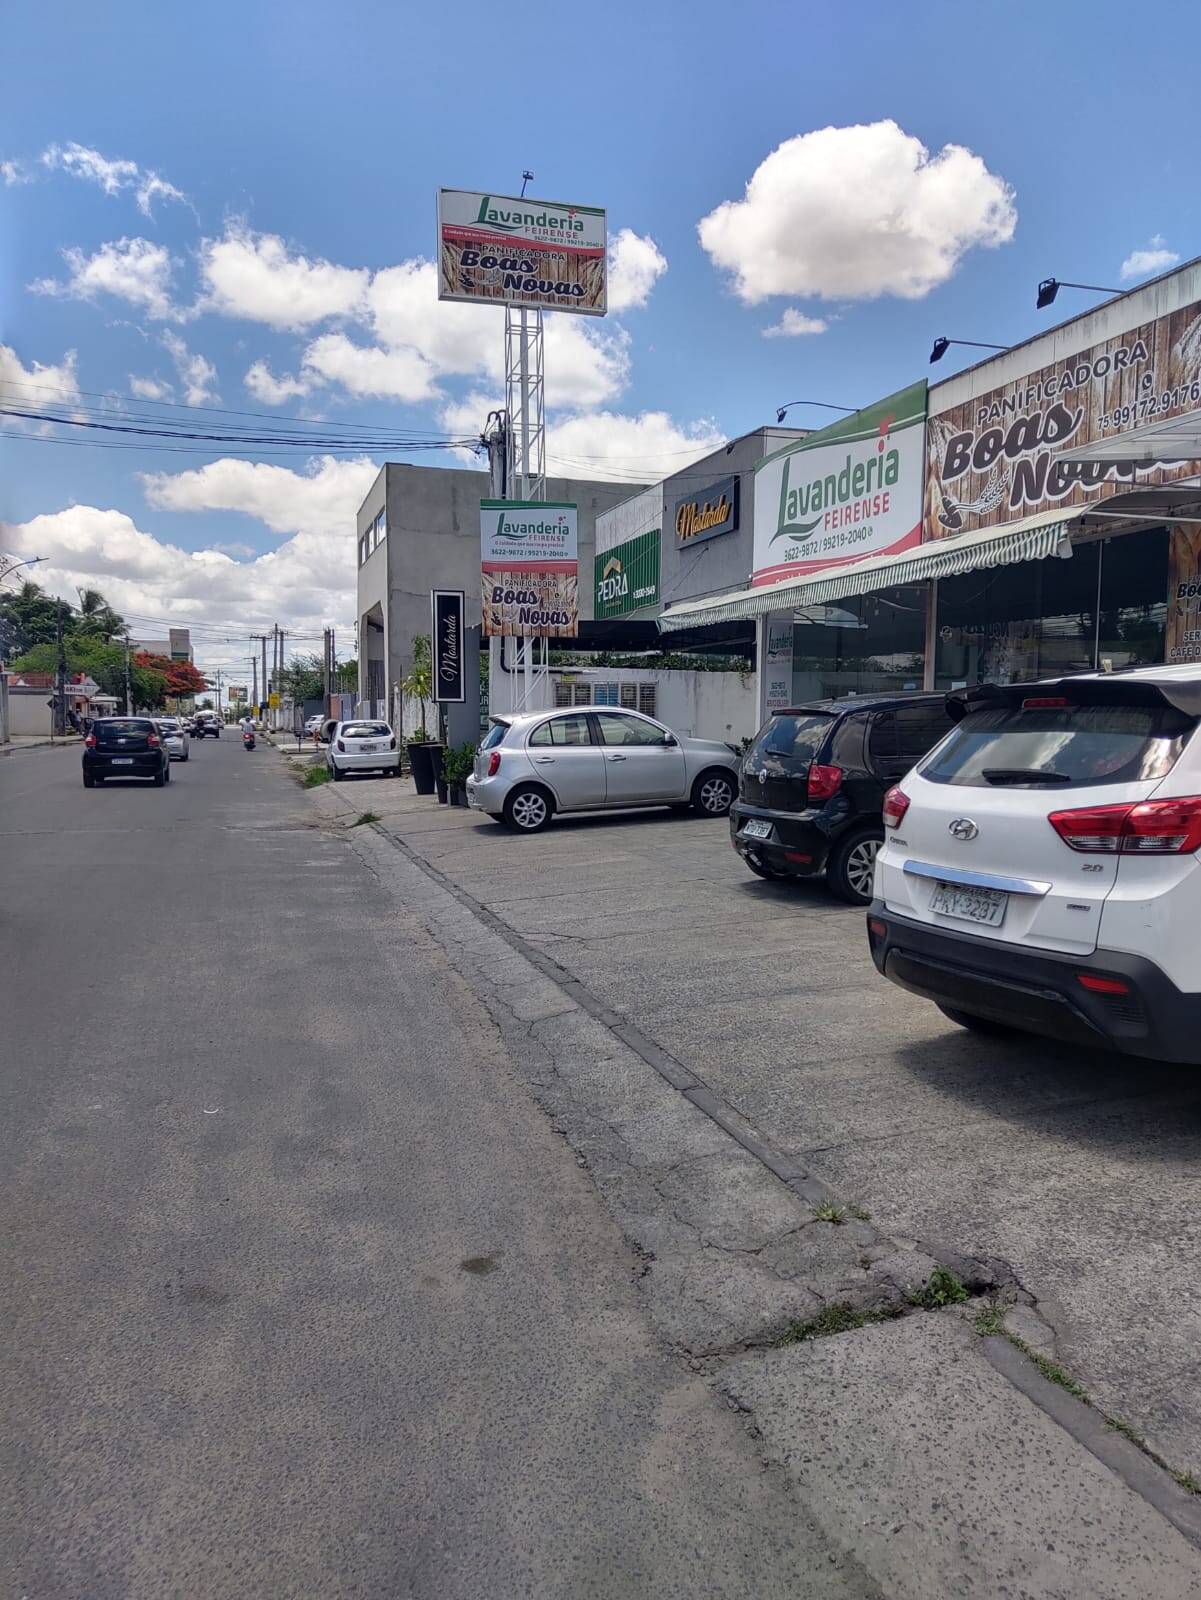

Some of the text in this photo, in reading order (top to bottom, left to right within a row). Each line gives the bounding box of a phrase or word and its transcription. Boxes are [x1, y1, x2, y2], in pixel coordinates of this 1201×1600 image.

[478, 197, 584, 231] Lavanderia
[525, 226, 579, 239] FEIRENSE
[460, 250, 538, 273] Boas
[482, 245, 565, 260] PANIFICADORA
[503, 273, 587, 296] Novas
[977, 340, 1148, 427] PANIFICADORA
[1098, 381, 1200, 430] 75 99172.9176
[943, 402, 1083, 480] Boas
[776, 439, 899, 536] Lavanderia
[497, 512, 569, 536] Lavanderia
[824, 492, 890, 531] FEIRENSE
[784, 541, 818, 562] 3622-9872
[823, 526, 867, 551] 99219-2040
[492, 586, 541, 605] Boas
[505, 580, 557, 588] PANIFICADORA
[598, 573, 629, 602] PEDRA
[519, 607, 571, 625] Novas
